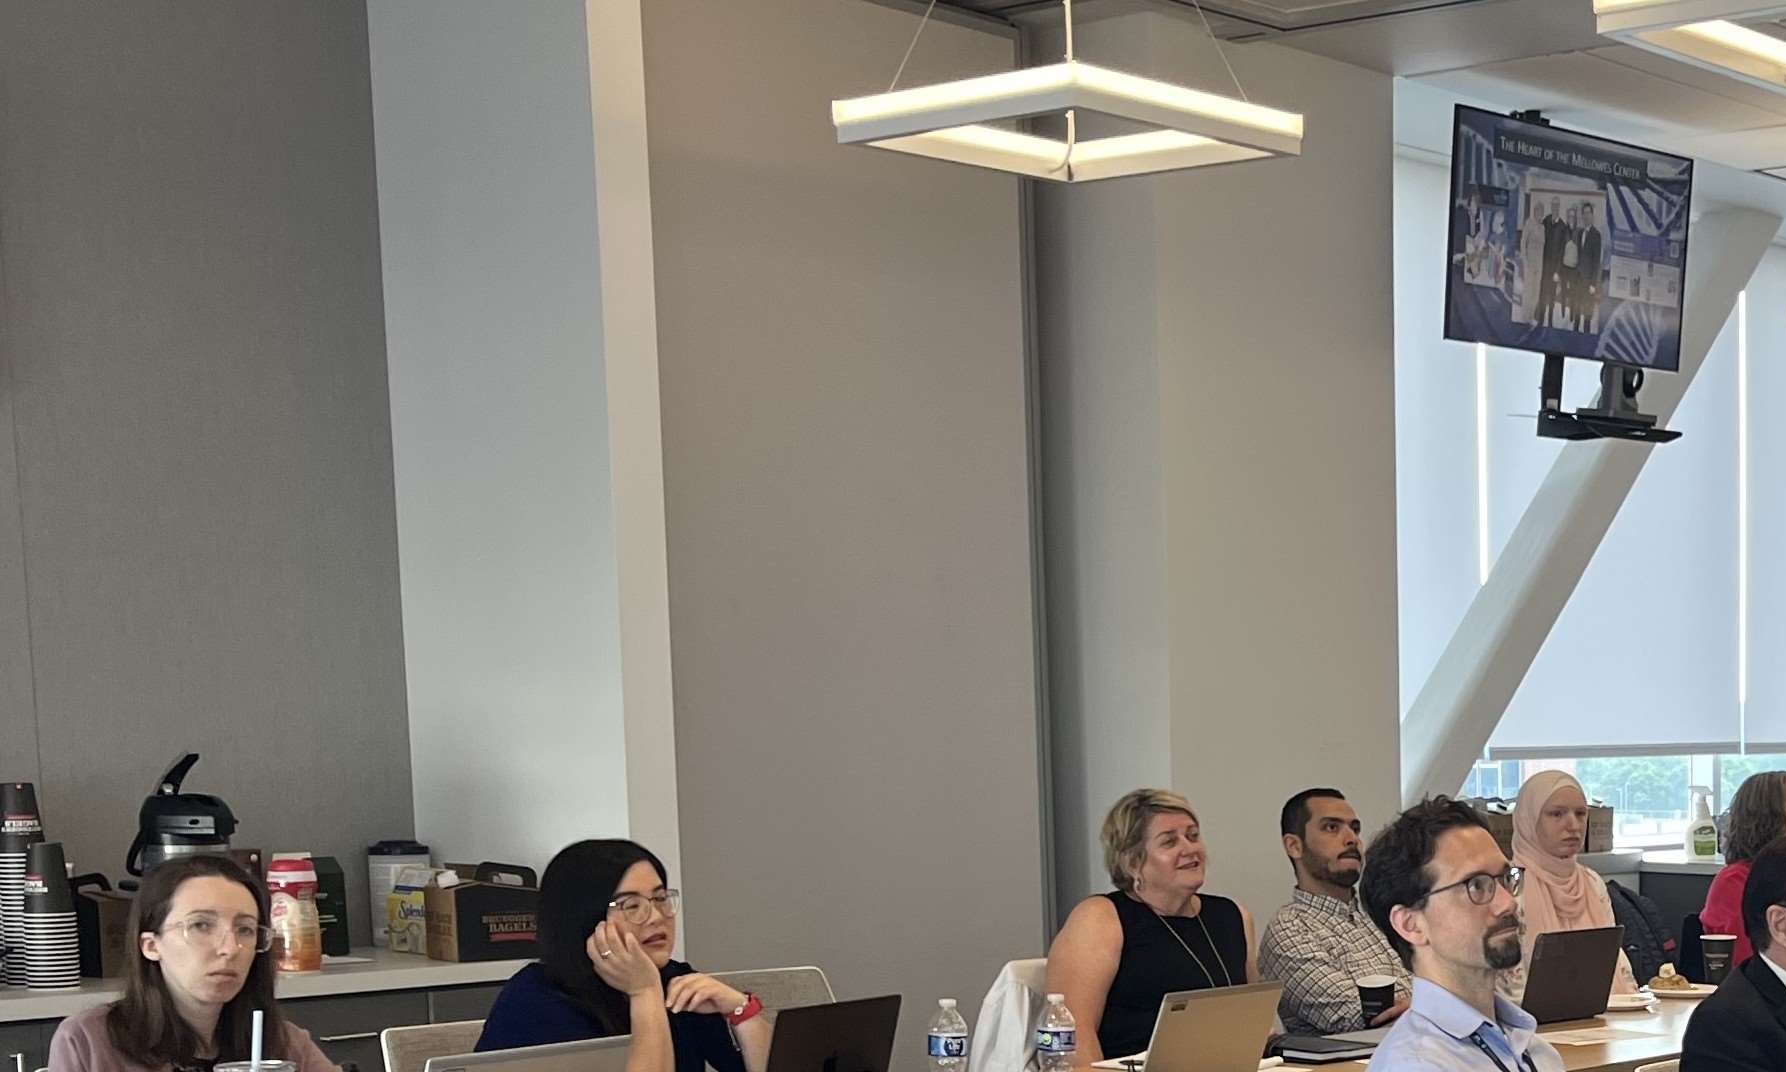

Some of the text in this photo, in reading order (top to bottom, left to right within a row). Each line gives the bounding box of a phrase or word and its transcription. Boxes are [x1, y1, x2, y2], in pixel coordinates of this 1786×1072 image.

[1501, 136, 1515, 153] THE
[1517, 140, 1543, 158] HEART
[1543, 149, 1555, 160] OF
[1556, 151, 1571, 164] THE
[399, 900, 425, 919] Splend
[489, 922, 537, 932] BAGELS
